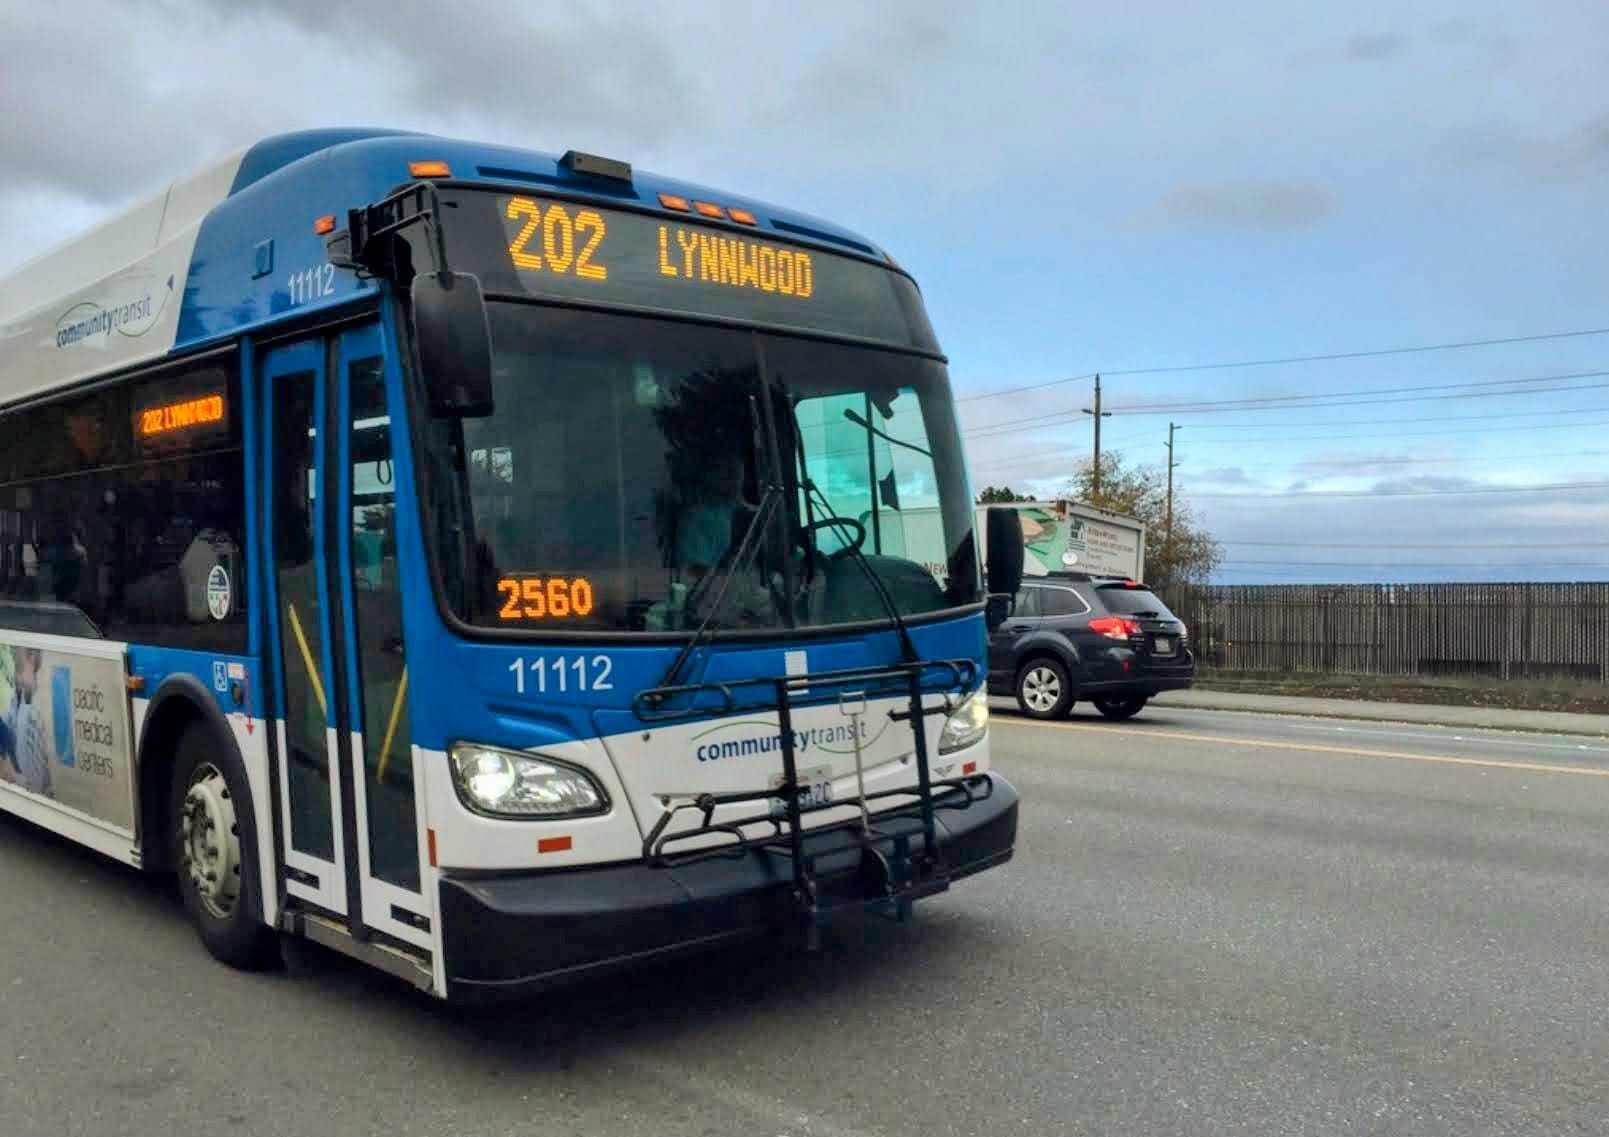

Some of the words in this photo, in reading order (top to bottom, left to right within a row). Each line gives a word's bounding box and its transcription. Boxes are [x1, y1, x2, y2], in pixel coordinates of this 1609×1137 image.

[505, 196, 607, 280] 202
[659, 225, 814, 297] LYNNWOOD
[288, 263, 335, 304] 11112
[143, 408, 164, 433] 202
[497, 578, 593, 618] 2560
[509, 655, 613, 693] 11112
